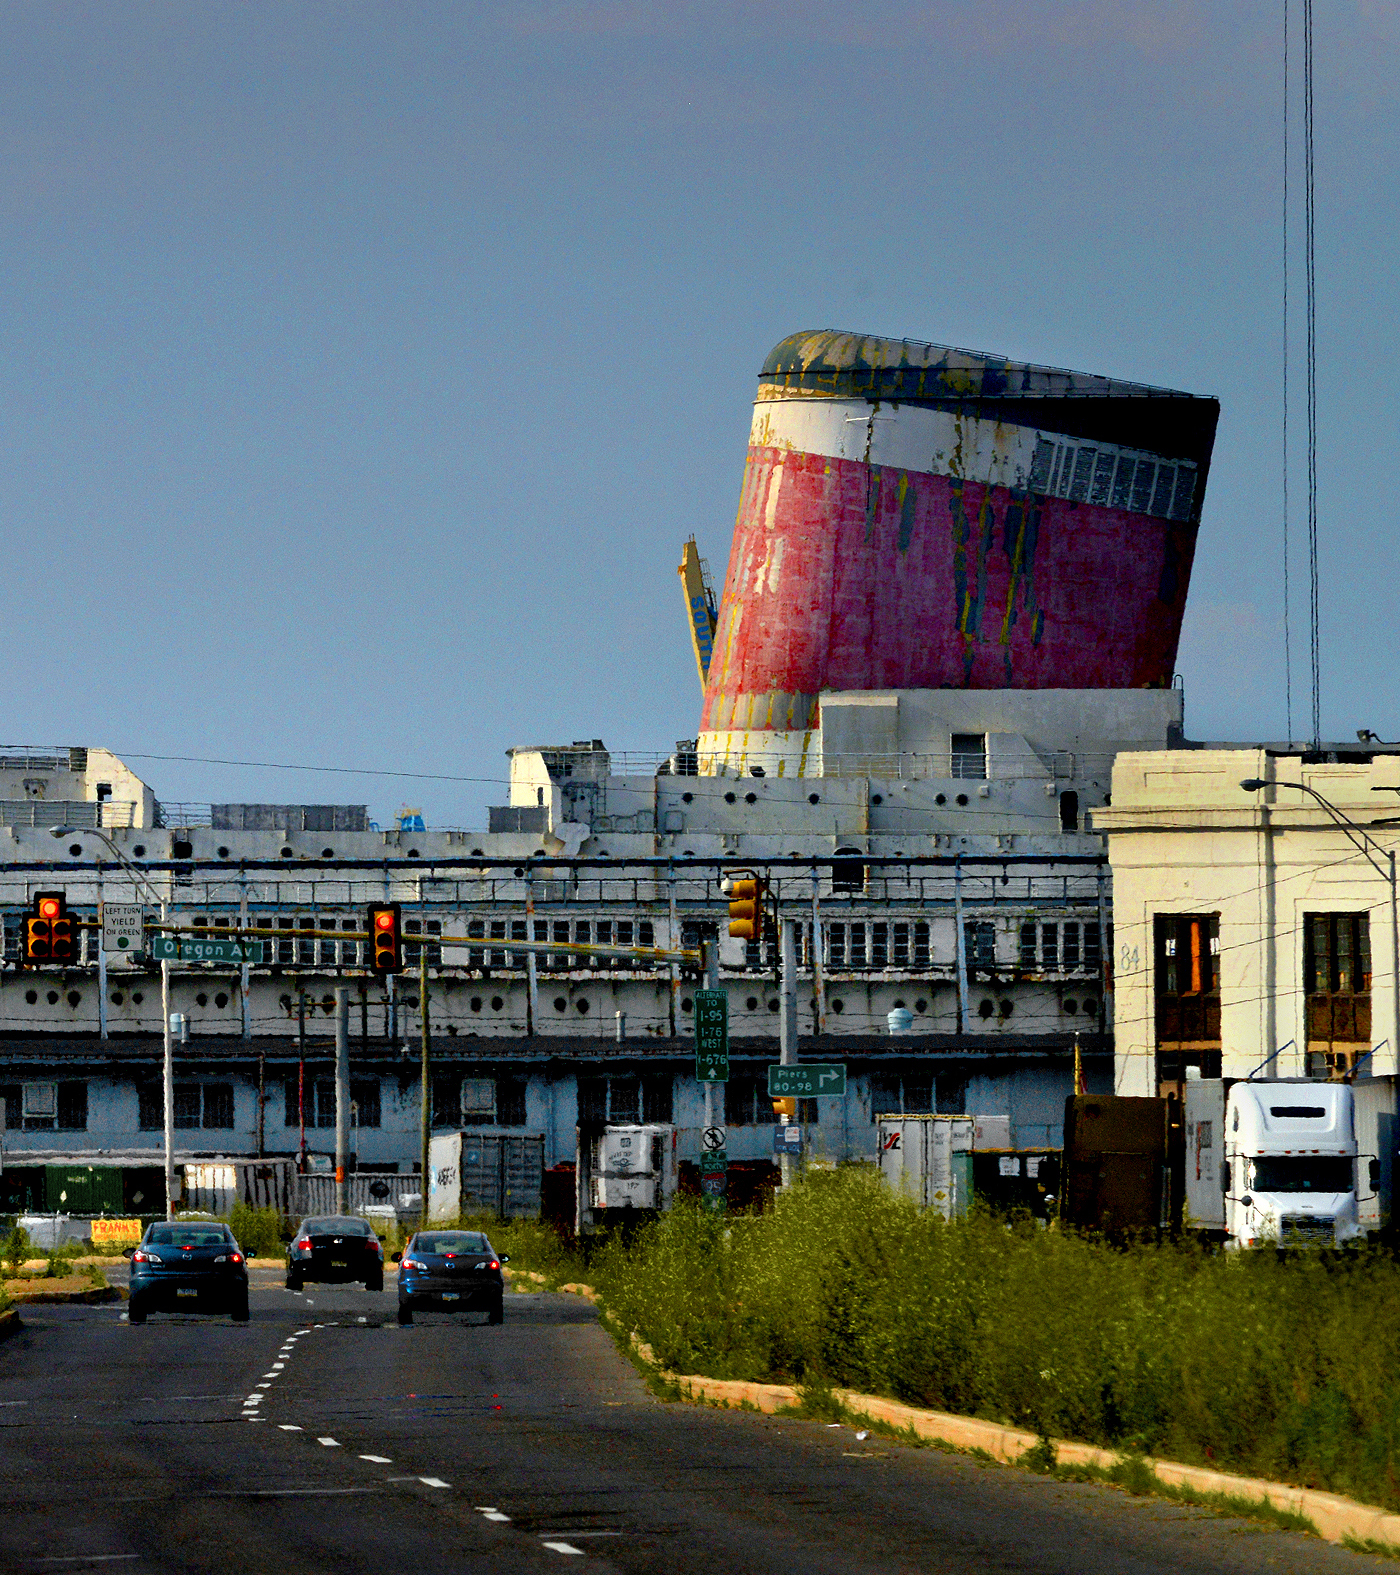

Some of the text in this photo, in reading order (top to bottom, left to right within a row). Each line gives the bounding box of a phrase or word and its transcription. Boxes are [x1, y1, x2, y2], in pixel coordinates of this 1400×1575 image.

[111, 917, 135, 925] YIELD
[164, 941, 252, 958] Oregon Av
[1121, 943, 1140, 970] 84
[701, 1010, 722, 1021] I-95
[701, 1027, 722, 1038] I-76
[701, 1039, 721, 1048] WEST
[699, 1054, 726, 1065] I-676
[777, 1070, 808, 1079] Piers
[773, 1082, 813, 1092] 80-98
[705, 1181, 721, 1193] 95
